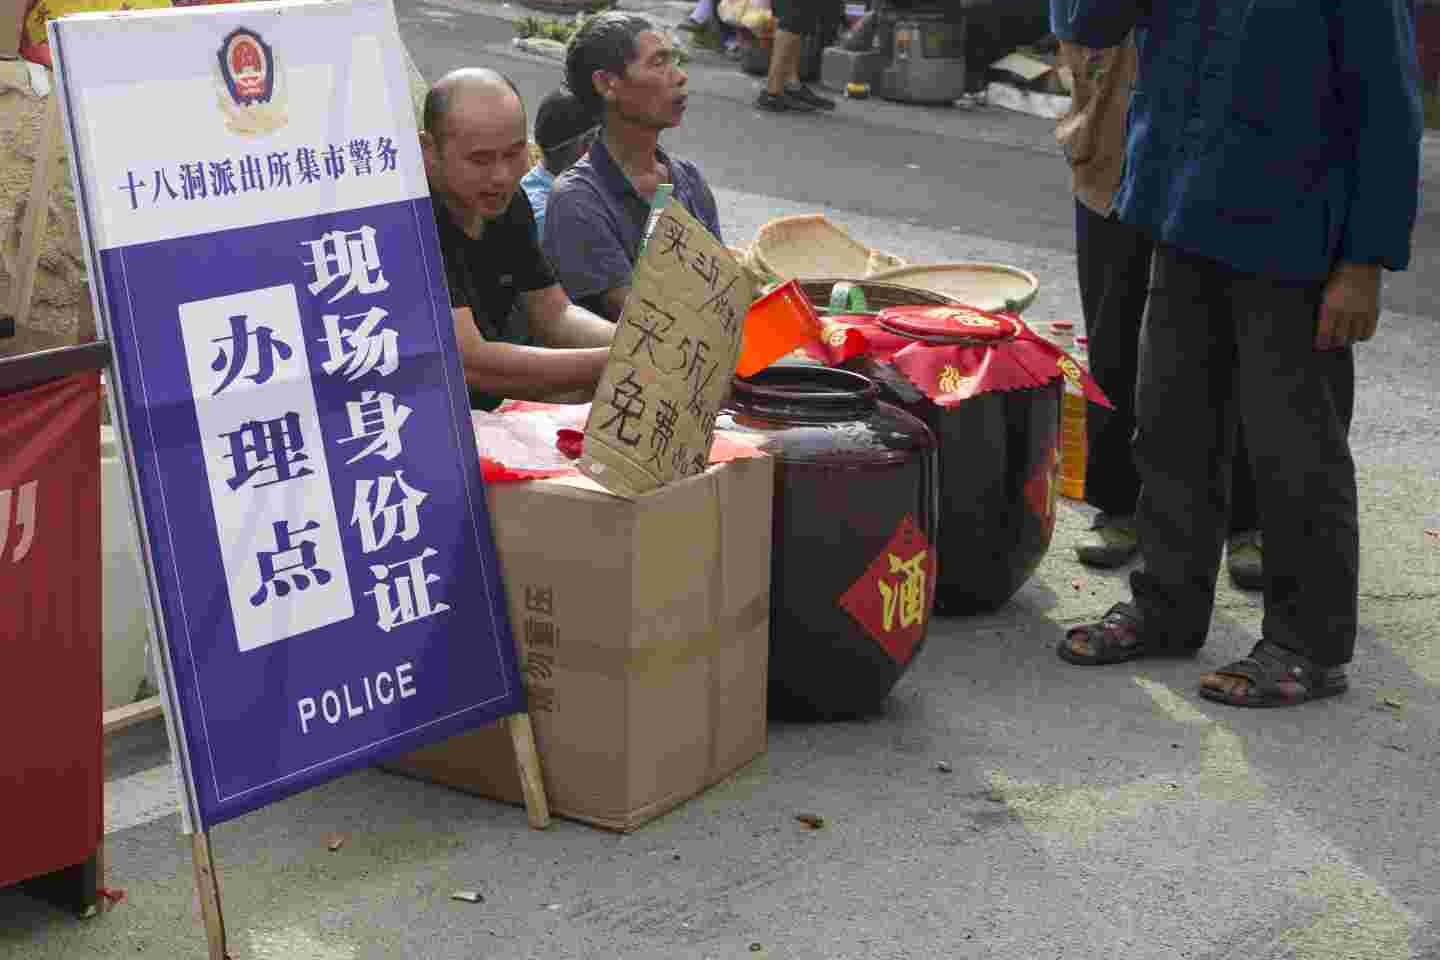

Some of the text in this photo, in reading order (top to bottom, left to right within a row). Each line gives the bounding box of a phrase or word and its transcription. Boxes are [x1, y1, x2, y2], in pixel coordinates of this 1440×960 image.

[119, 136, 399, 210] 十八洞派出所集市警务
[211, 313, 333, 608] 办理点
[300, 224, 450, 633] 现场身份证
[879, 549, 928, 632] 酒
[297, 662, 418, 735] POLICE
